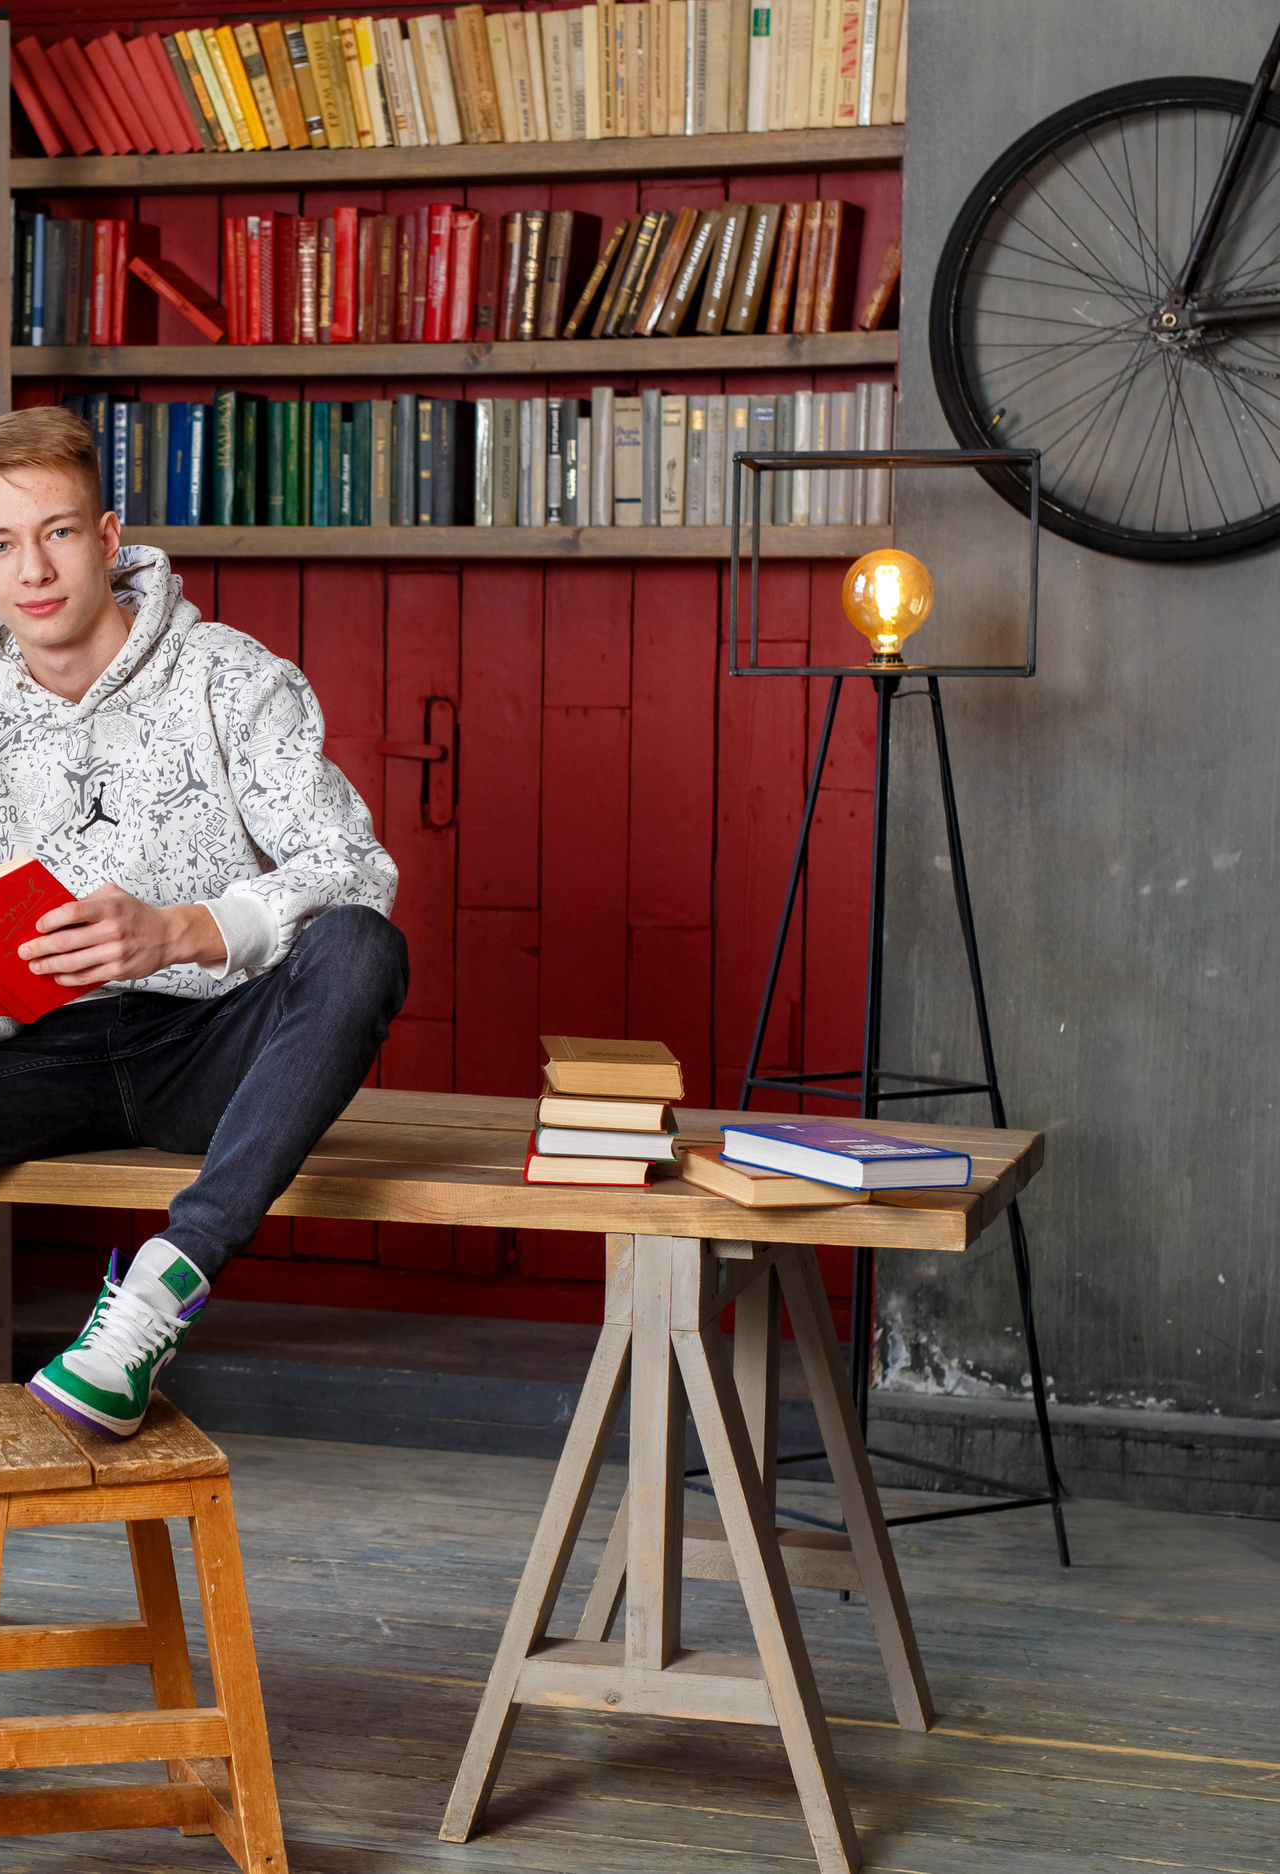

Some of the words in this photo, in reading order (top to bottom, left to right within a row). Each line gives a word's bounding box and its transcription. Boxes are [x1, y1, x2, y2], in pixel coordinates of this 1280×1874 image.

[313, 40, 329, 79] ГРИН
[552, 35, 562, 82] Есенин
[323, 87, 340, 128] ГРЭМ
[554, 86, 567, 130] Сергей
[217, 392, 232, 468] НАДЕЖДА
[502, 408, 511, 438] МИРА
[502, 445, 510, 499] ОТКРЫТИЕ
[162, 632, 181, 655] 38
[233, 723, 251, 747] 38
[10, 774, 29, 801] DEATH
[168, 1276, 185, 1293] AIR
